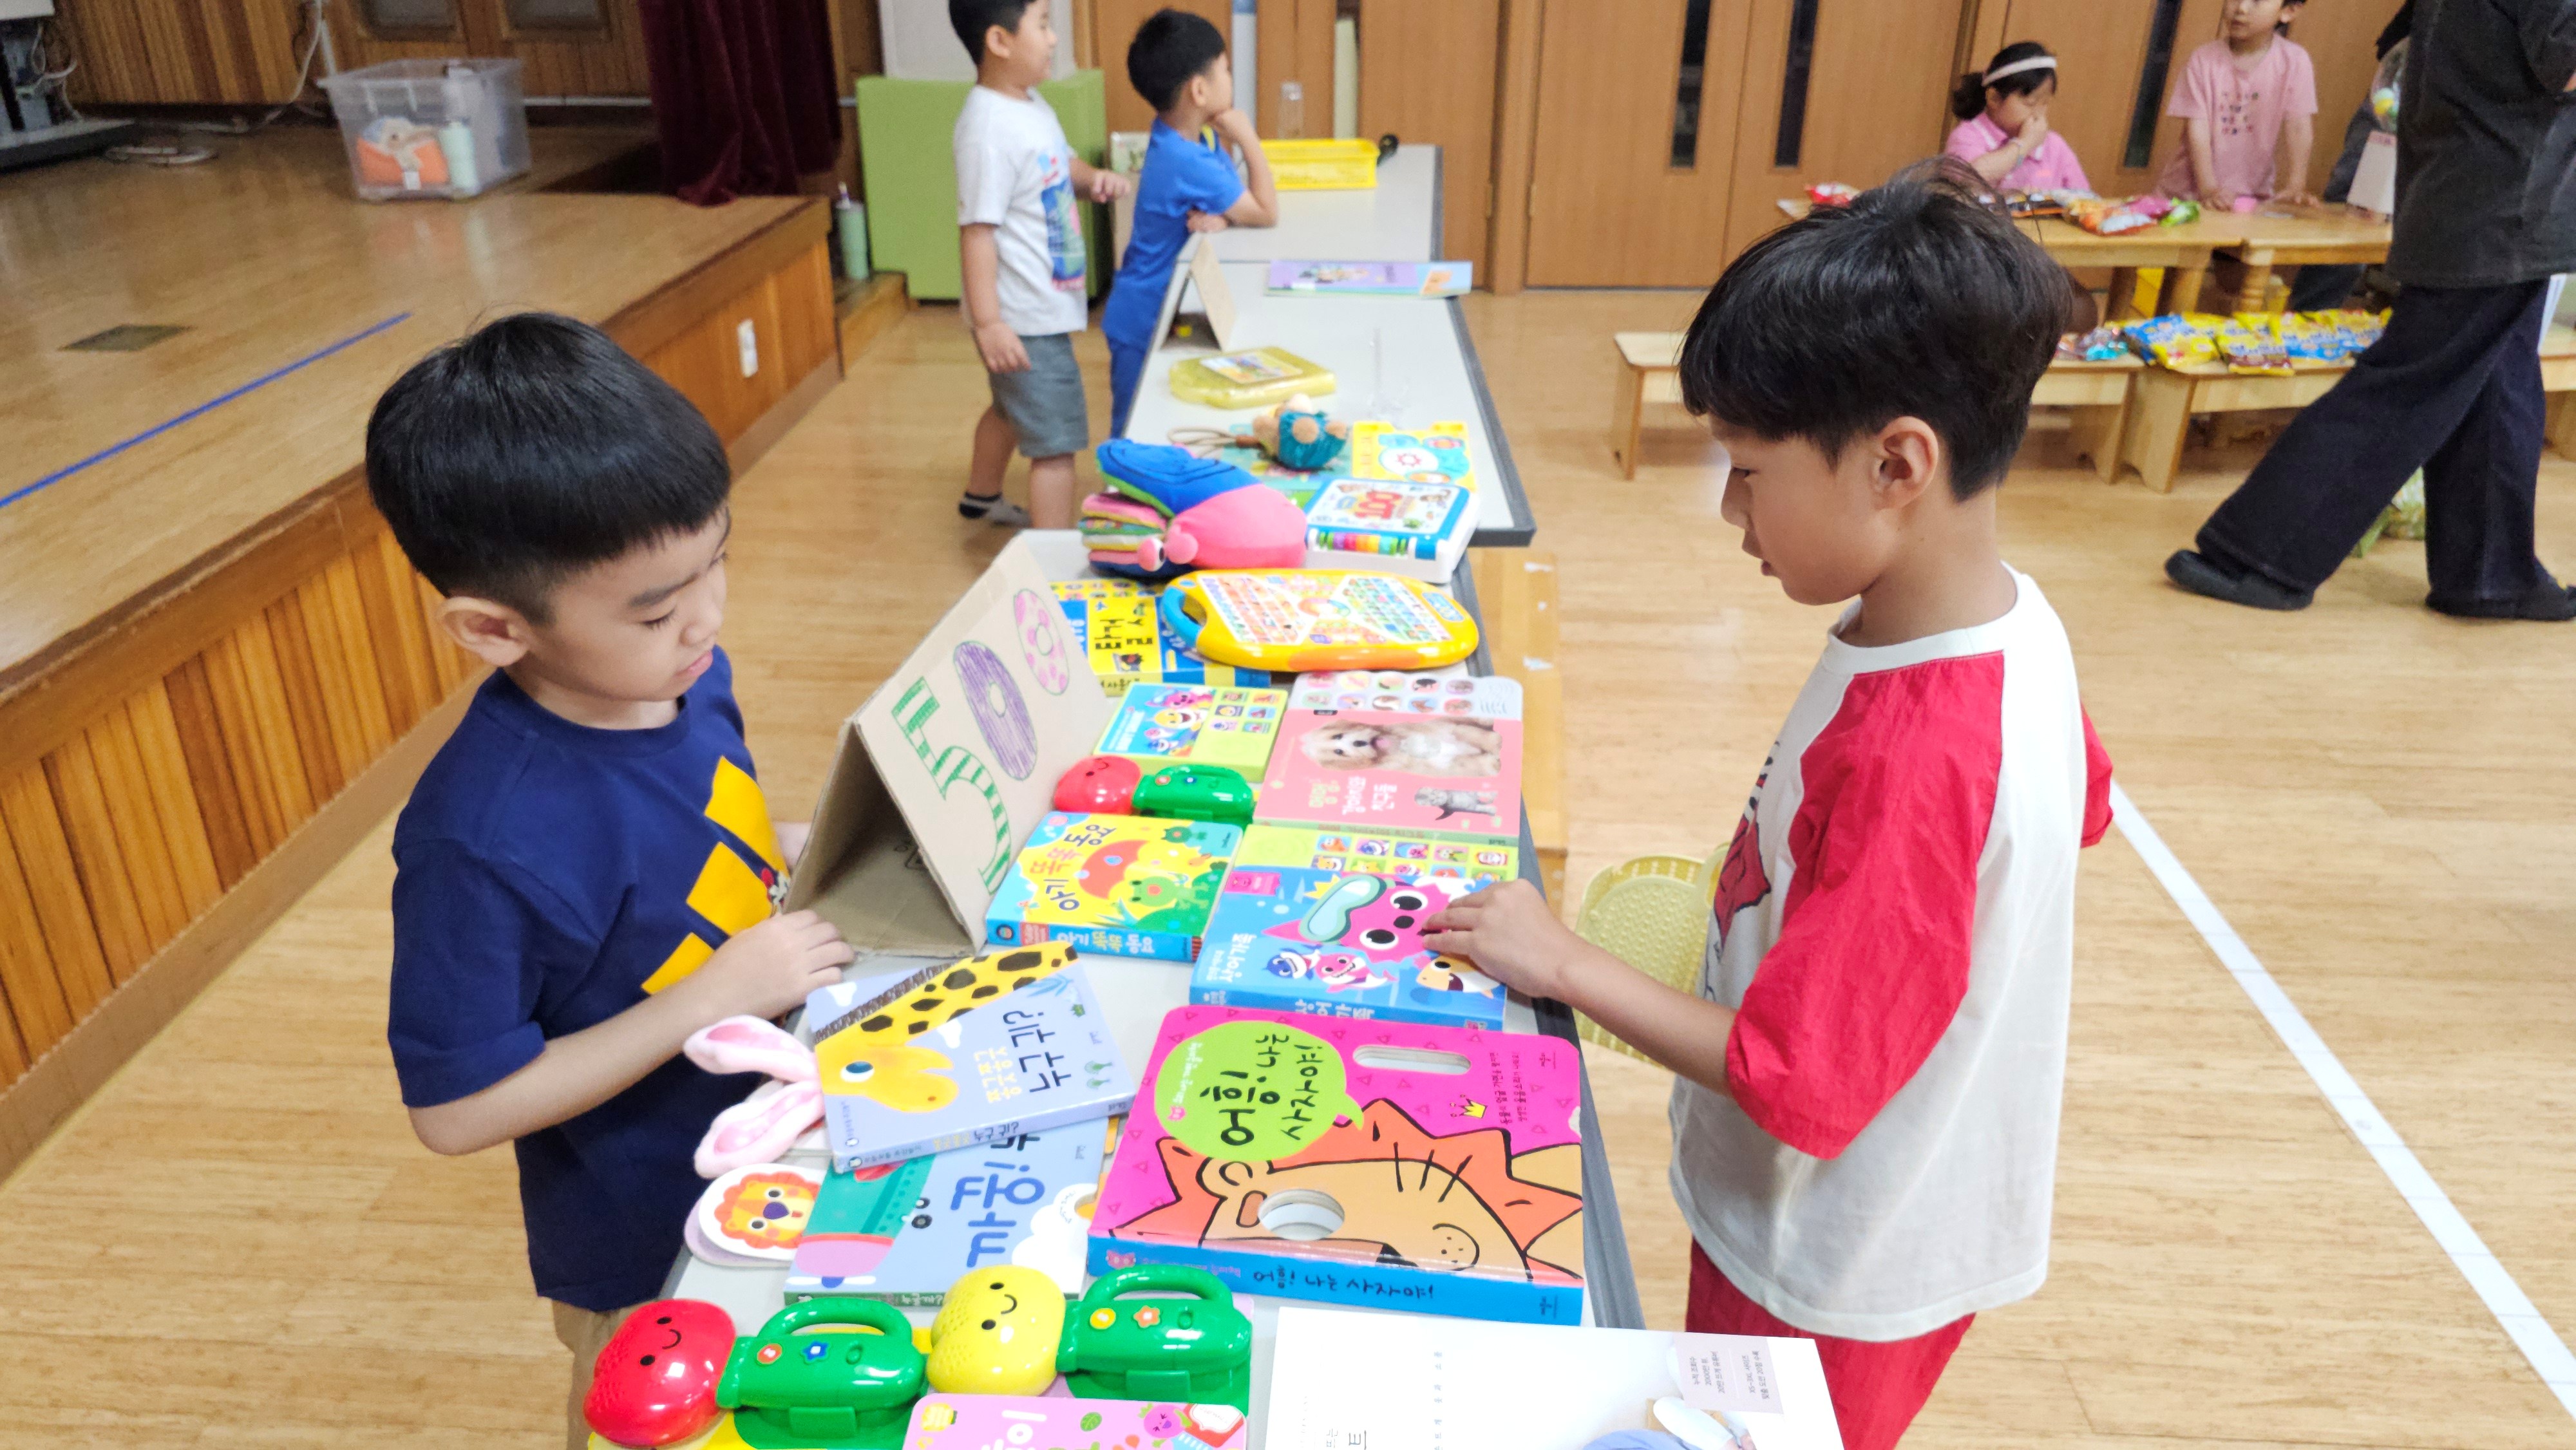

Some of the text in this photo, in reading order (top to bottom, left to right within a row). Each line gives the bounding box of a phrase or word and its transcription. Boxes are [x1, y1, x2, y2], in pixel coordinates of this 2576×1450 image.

[892, 588, 1070, 896] 500
[1064, 824, 1118, 847] 동요
[1043, 878, 1080, 911] 아기
[1057, 931, 1090, 946] 아기
[1124, 934, 1155, 954] 동요
[1002, 1009, 1072, 1095] 누구 귀?
[1200, 1070, 1280, 1146] 어흥!
[1256, 1033, 1290, 1073] 나는
[1281, 1044, 1320, 1142] 사자야!
[950, 1161, 1045, 1268] 까꿍!
[1253, 1267, 1296, 1290] 어흥!
[1305, 1273, 1338, 1292] 나는
[1346, 1276, 1434, 1300] 사자야!
